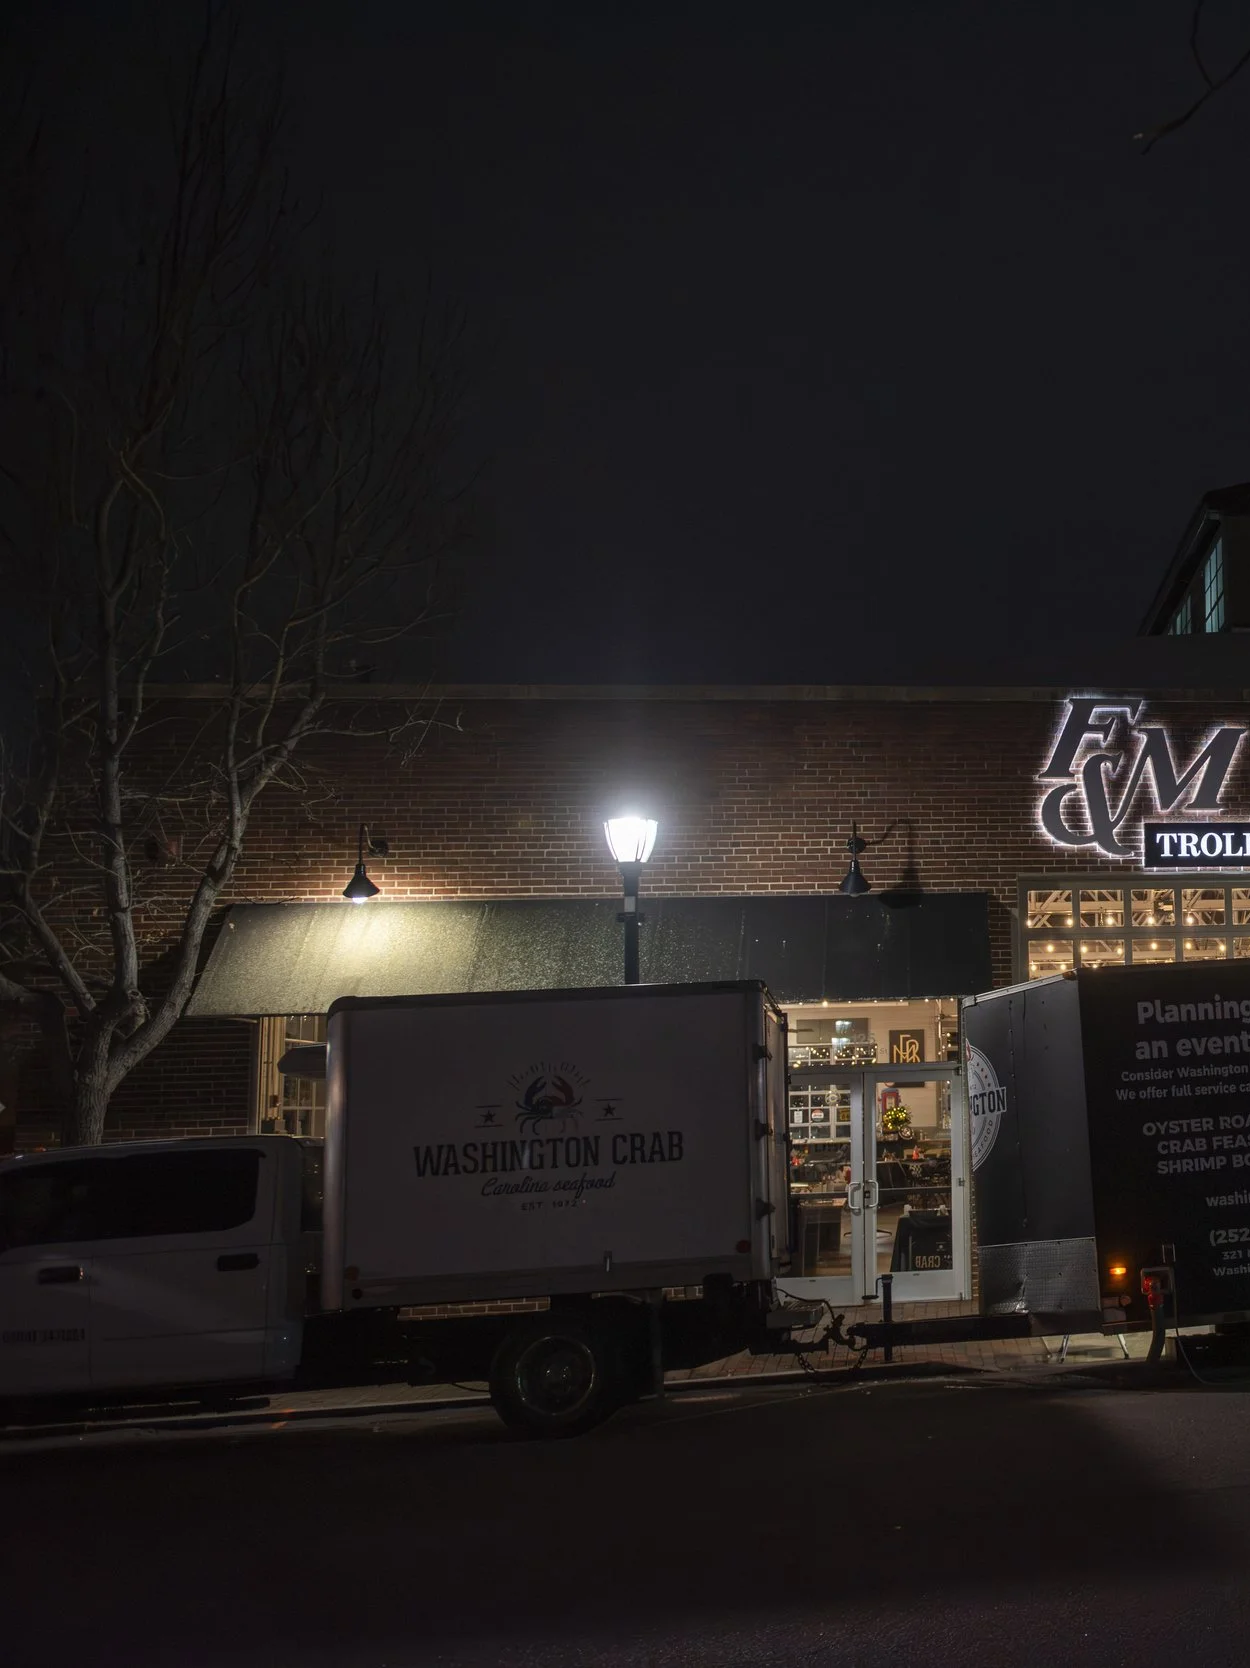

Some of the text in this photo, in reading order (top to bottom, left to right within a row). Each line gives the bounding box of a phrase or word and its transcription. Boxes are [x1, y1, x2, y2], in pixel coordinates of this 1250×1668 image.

[1135, 1039, 1168, 1060] an
[1120, 1069, 1174, 1082] Consider
[1176, 1062, 1249, 1078] Washington
[1115, 1087, 1136, 1101] We
[1138, 1085, 1168, 1099] offer
[1171, 1084, 1192, 1097] full
[1194, 1081, 1237, 1096] service
[1142, 1117, 1215, 1137] OYSTER
[413, 1131, 684, 1177] WASHINGTON CRAB
[1157, 1137, 1208, 1155] CRAB
[1157, 1155, 1228, 1175] SHRIMP
[480, 1171, 617, 1200] Carolina seafood
